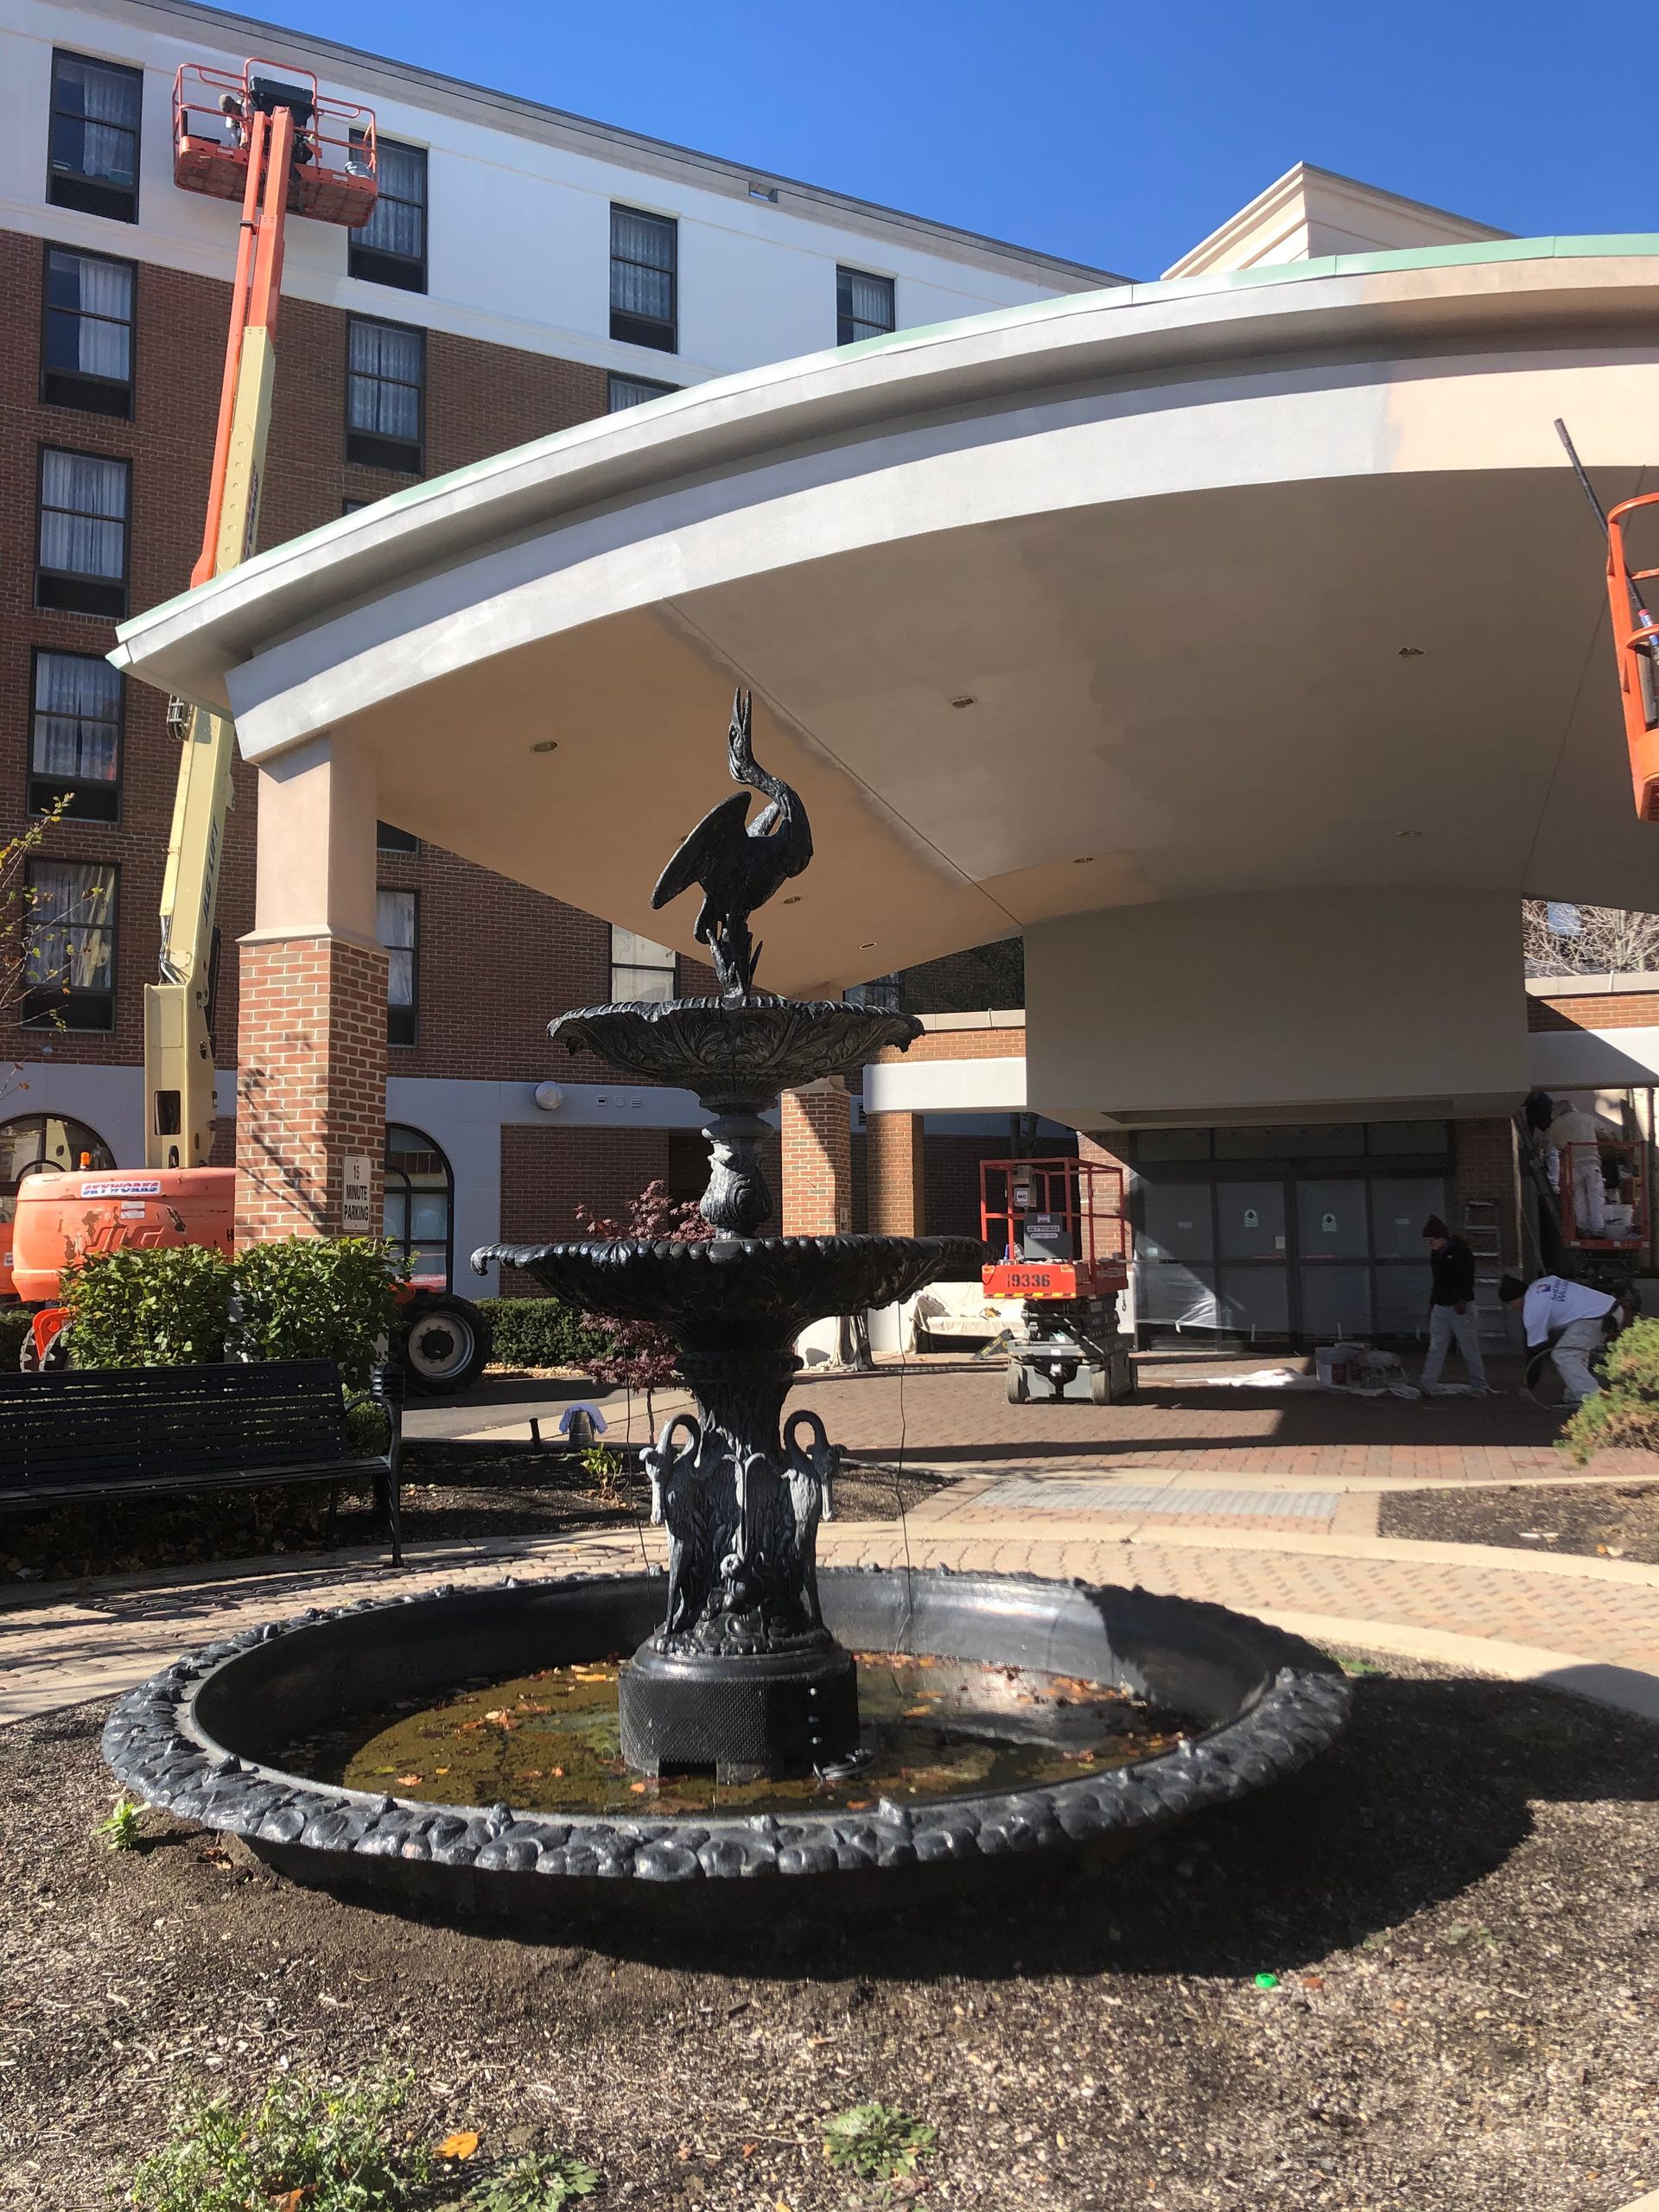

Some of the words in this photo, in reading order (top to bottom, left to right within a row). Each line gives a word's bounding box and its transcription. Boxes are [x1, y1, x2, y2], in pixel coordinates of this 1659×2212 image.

[208, 816, 218, 874] LIFT
[353, 1165, 360, 1180] 15
[83, 1182, 160, 1195] SKYWORKS
[346, 1184, 368, 1201] MINUTE
[344, 1205, 369, 1221] PARKING
